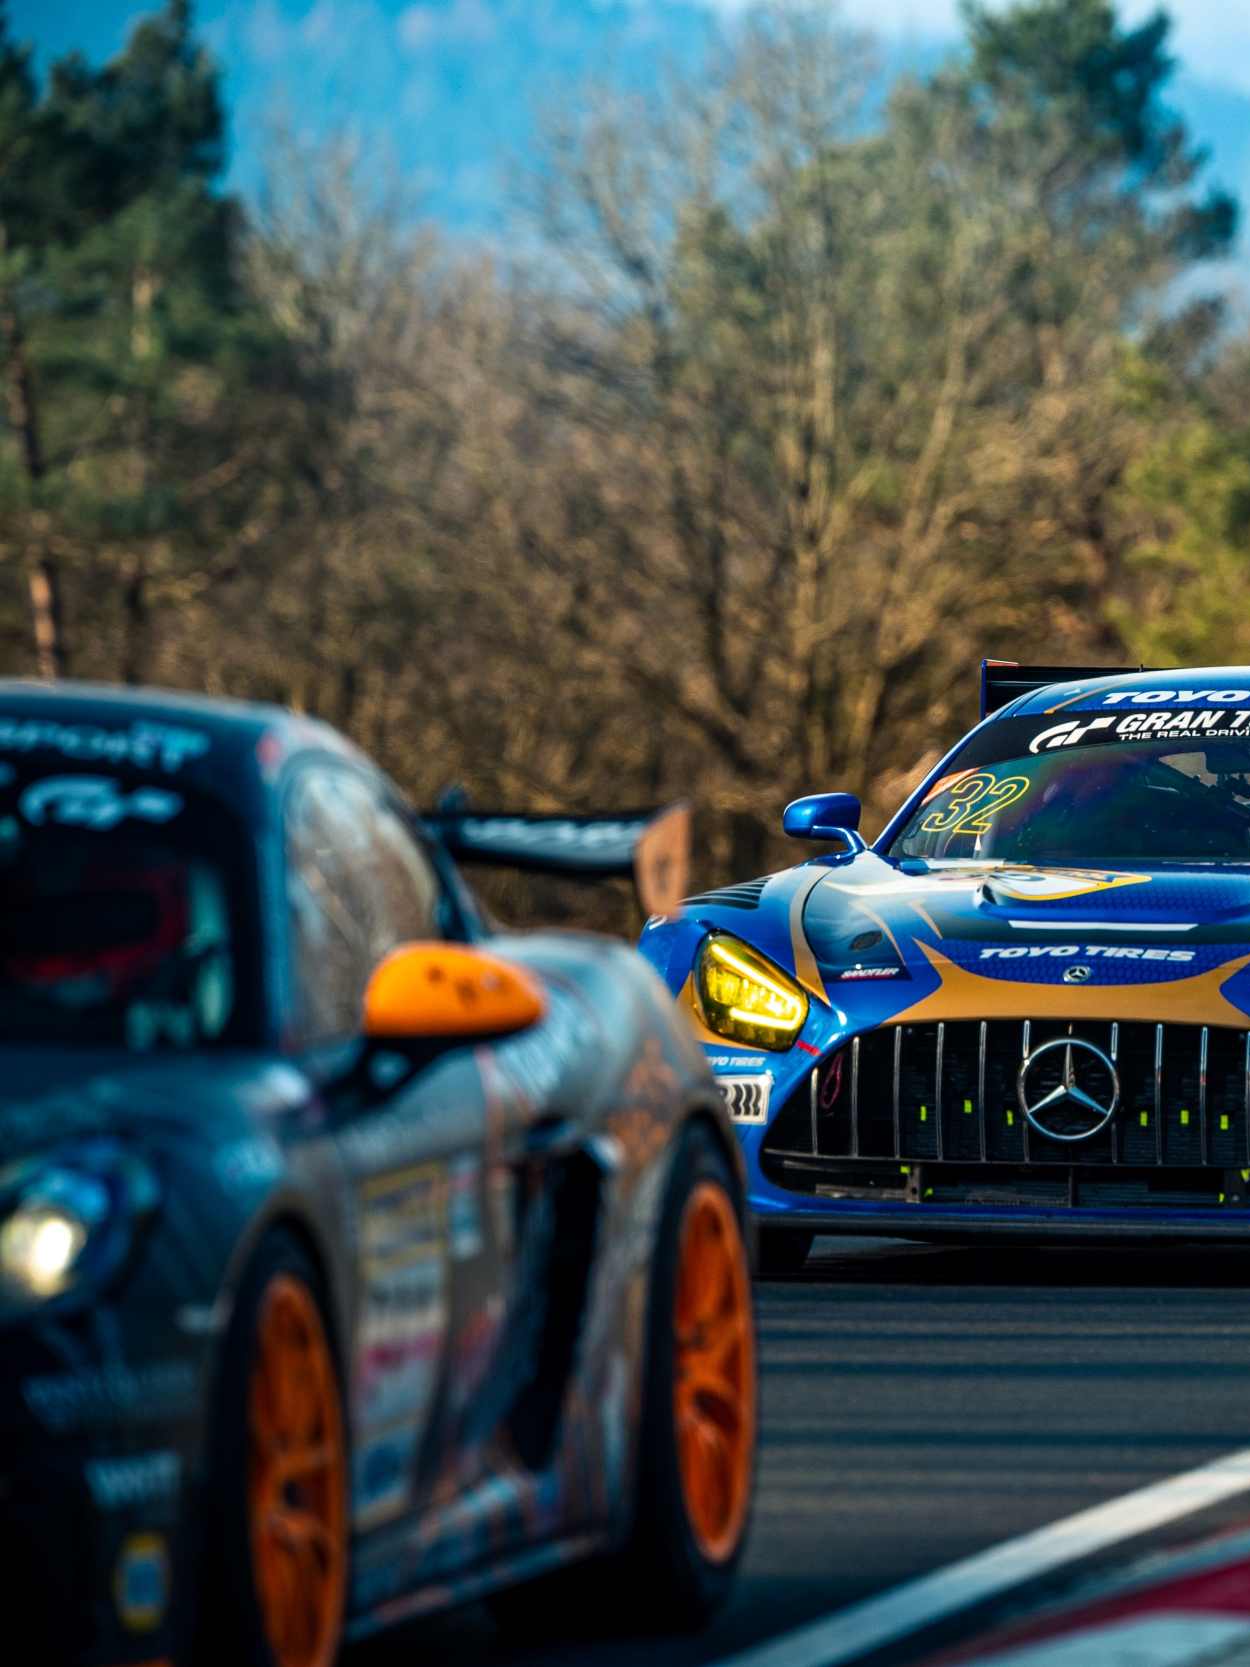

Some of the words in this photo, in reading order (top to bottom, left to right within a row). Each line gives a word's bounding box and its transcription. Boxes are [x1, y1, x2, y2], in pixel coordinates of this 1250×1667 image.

[1103, 690, 1250, 706] TOYO
[1116, 710, 1226, 733] GRAN
[1119, 732, 1152, 741] THE
[1156, 729, 1201, 738] REAL
[921, 772, 1030, 834] 32
[980, 945, 1080, 959] TOYO
[1085, 945, 1196, 962] TIRES
